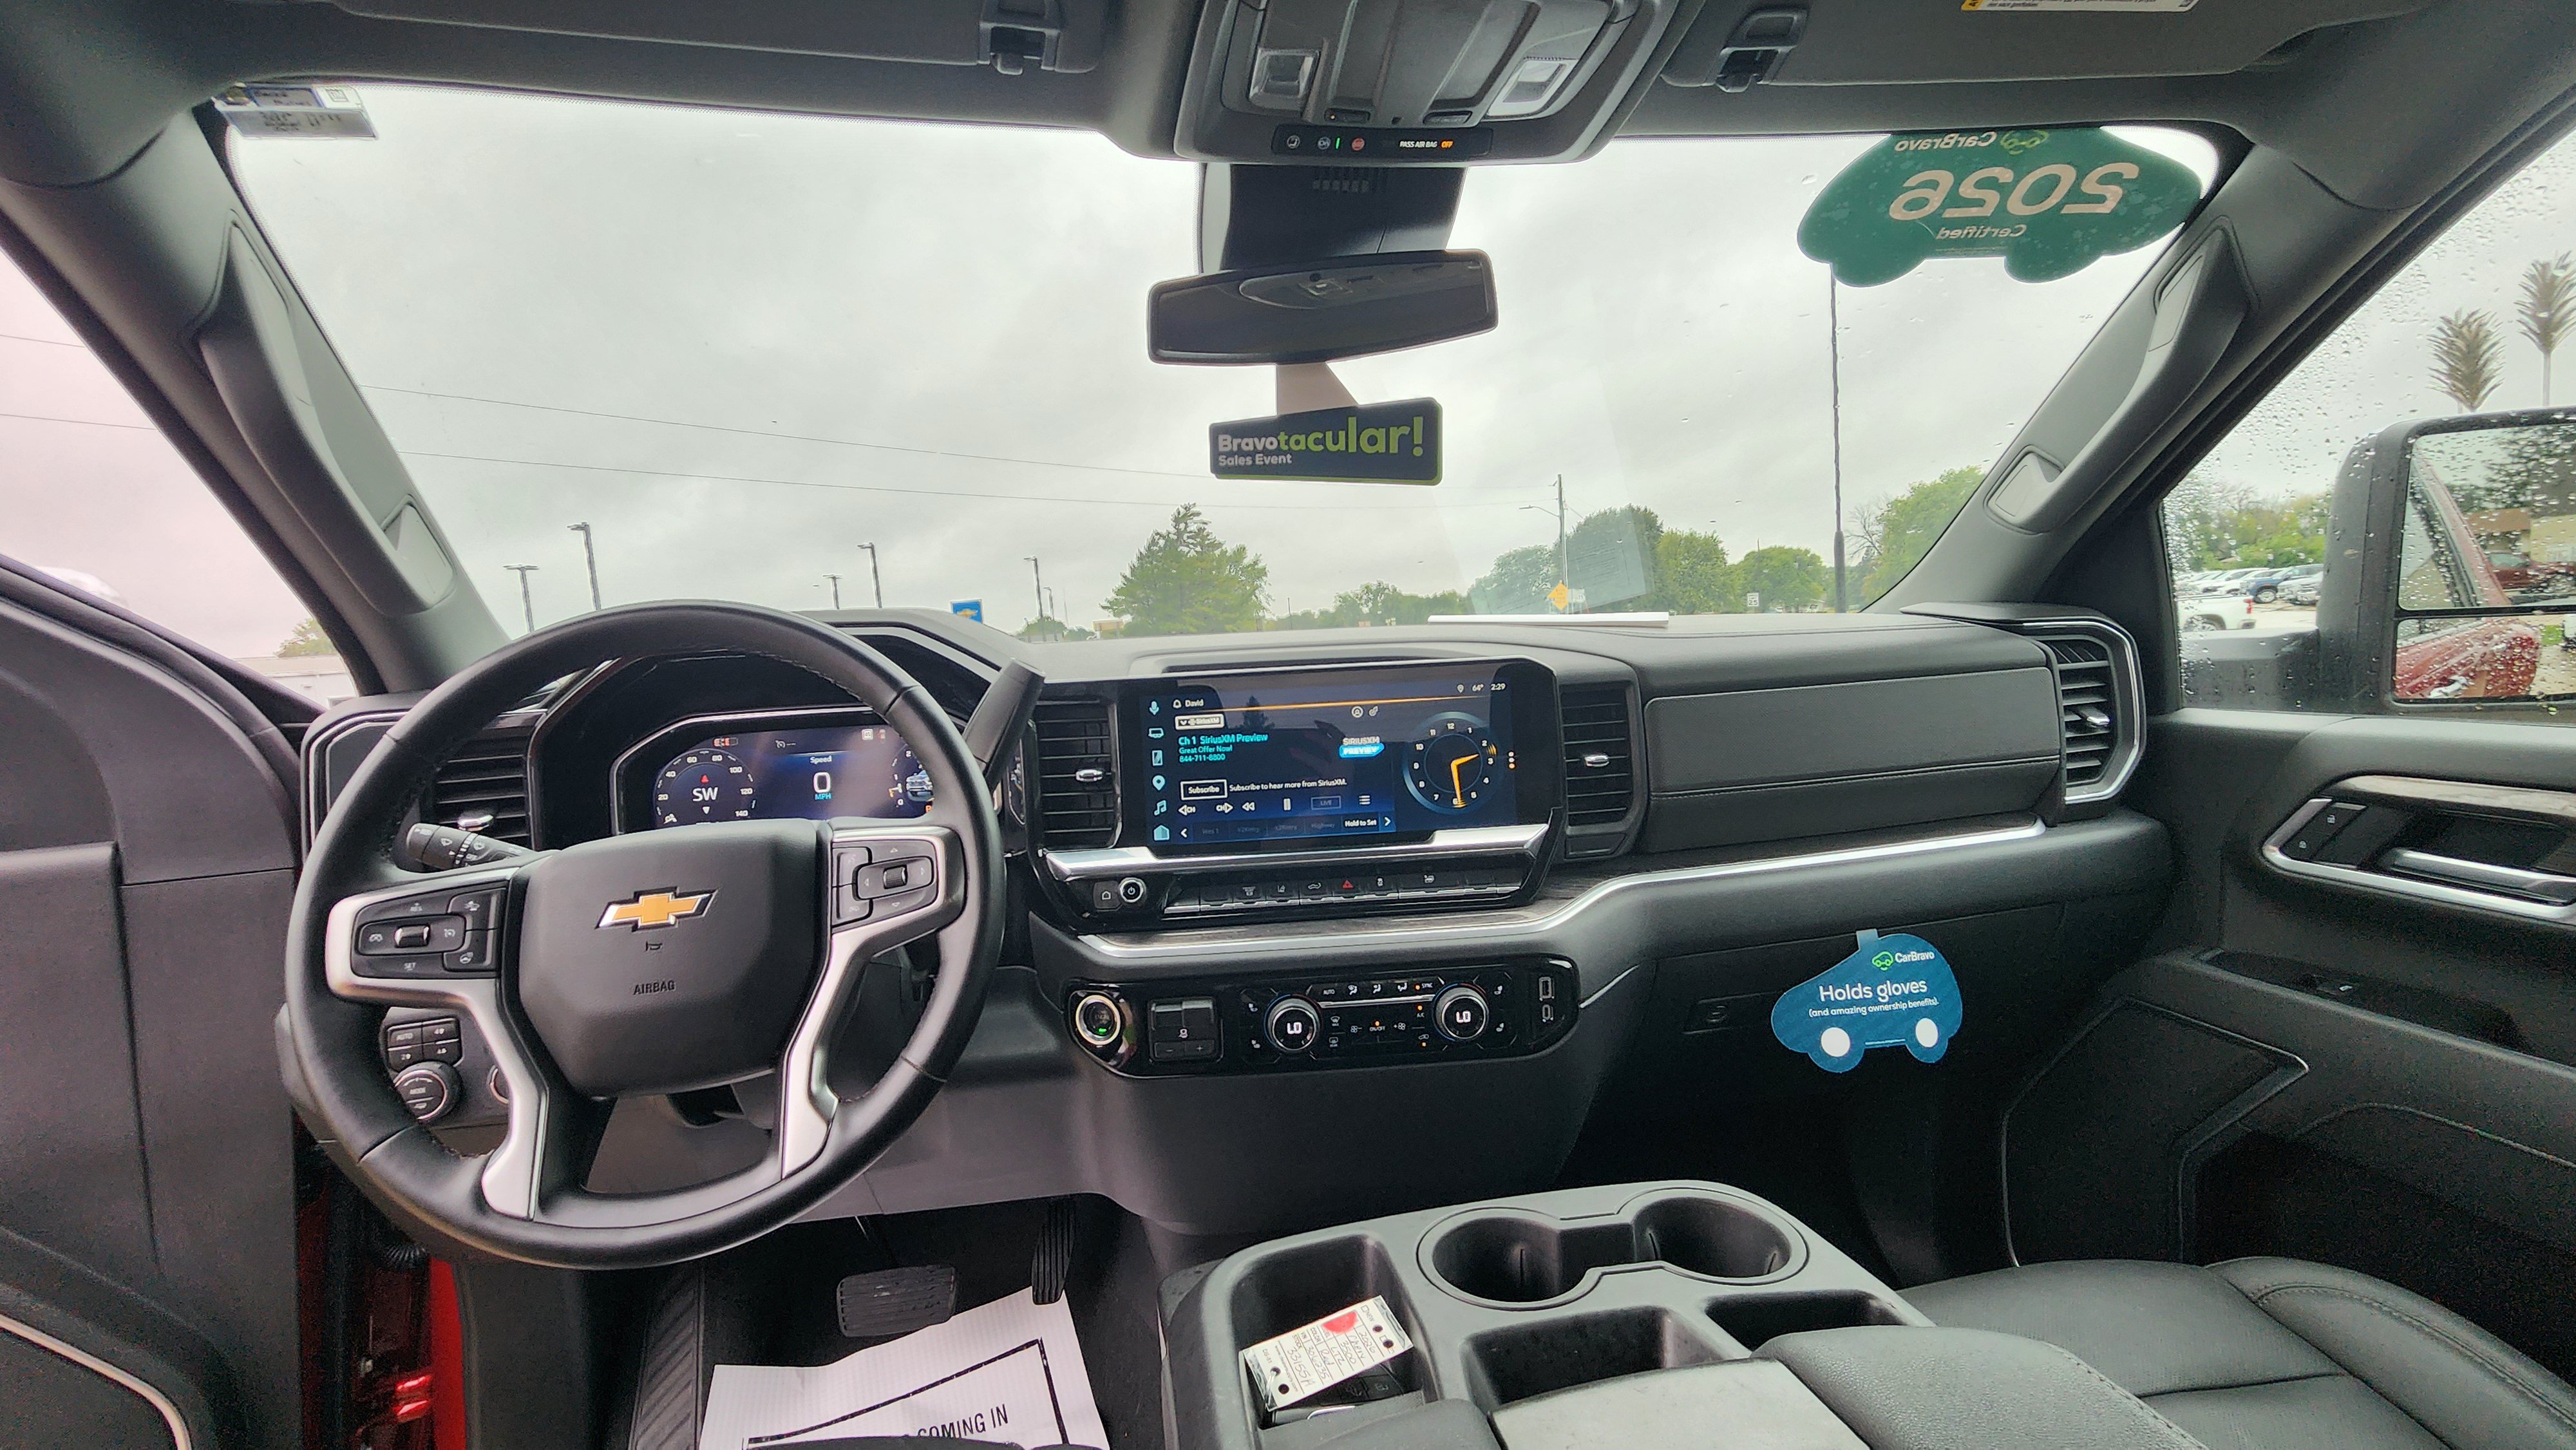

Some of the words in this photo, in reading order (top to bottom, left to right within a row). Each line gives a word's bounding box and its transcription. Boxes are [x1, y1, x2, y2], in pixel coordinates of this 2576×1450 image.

[1217, 416, 1424, 457] Bravotacular!
[1218, 453, 1253, 467] Sales
[1256, 453, 1293, 466] Event
[1184, 699, 1204, 707] David
[1178, 737, 1191, 746] Ch
[1191, 736, 1197, 745] 1
[1200, 734, 1235, 745] SiriusXM
[1236, 733, 1268, 743] Preview
[1342, 736, 1380, 745] SIRIUSXM
[1179, 746, 1197, 755] Great
[1198, 745, 1215, 753] Offer
[810, 755, 832, 765] Speed
[813, 772, 831, 793] 0
[1229, 783, 1260, 792] Subscribe
[692, 787, 718, 802] SW
[1188, 785, 1220, 794] Subscribe
[1895, 951, 1935, 963] CarBravo
[633, 980, 676, 995] AIRBAG
[1819, 983, 1873, 1002] Holds
[1877, 980, 1927, 1003] gloves
[1808, 1008, 1830, 1018] (and
[1831, 1004, 1867, 1015] amazing
[1868, 1001, 1908, 1013] ownership
[1455, 1011, 1472, 1023] LO
[1287, 1022, 1302, 1035] LO
[1311, 1326, 1321, 1343] COLOR
[1292, 1334, 1302, 1350] STOCK
[990, 1404, 1009, 1428] IN
